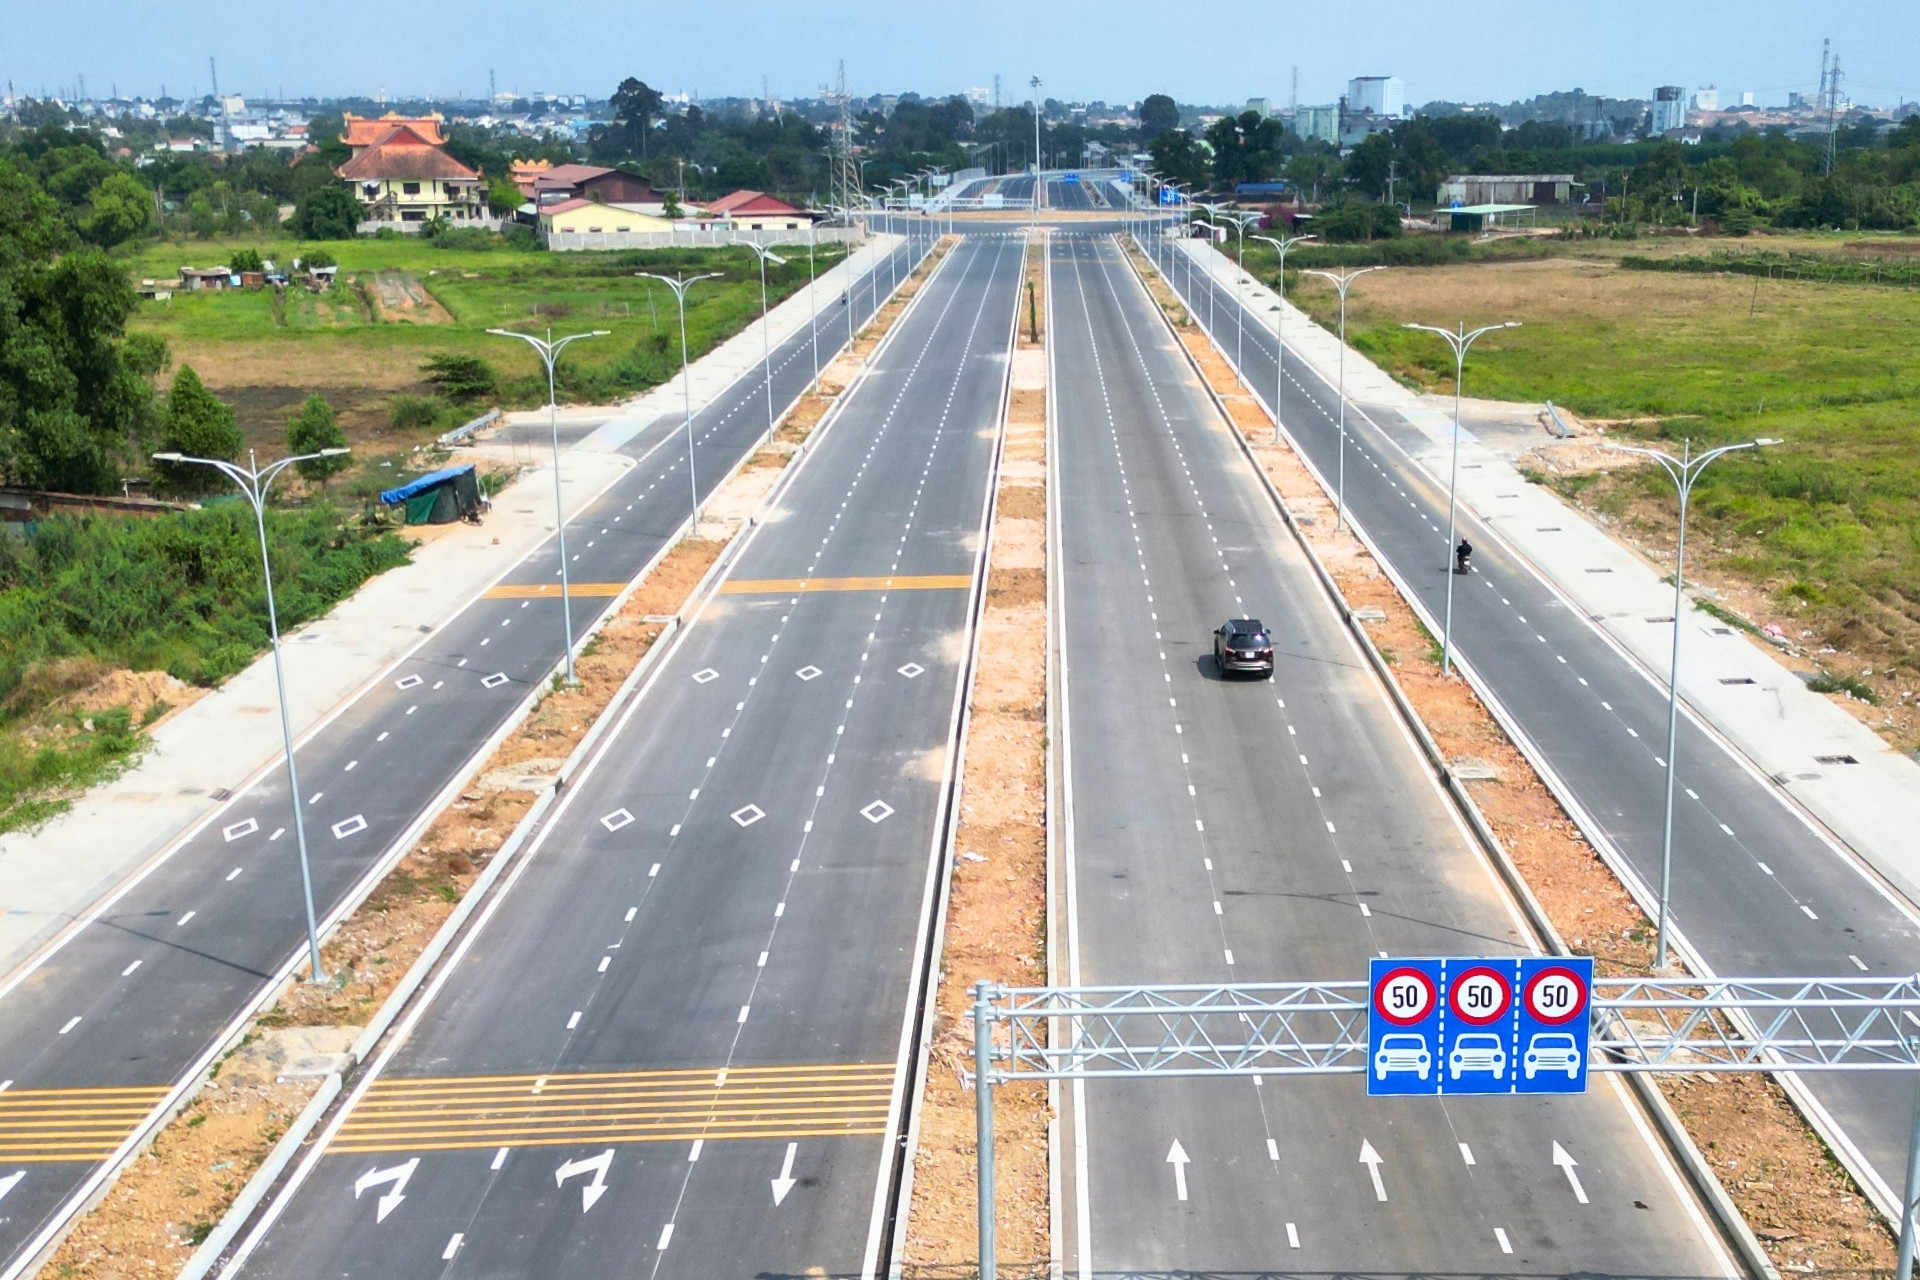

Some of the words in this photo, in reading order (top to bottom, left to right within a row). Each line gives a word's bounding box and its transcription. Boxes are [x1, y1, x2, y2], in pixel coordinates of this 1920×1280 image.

[1392, 985, 1417, 1008] 50
[1467, 985, 1492, 1008] 50
[1542, 984, 1568, 1008] 50
